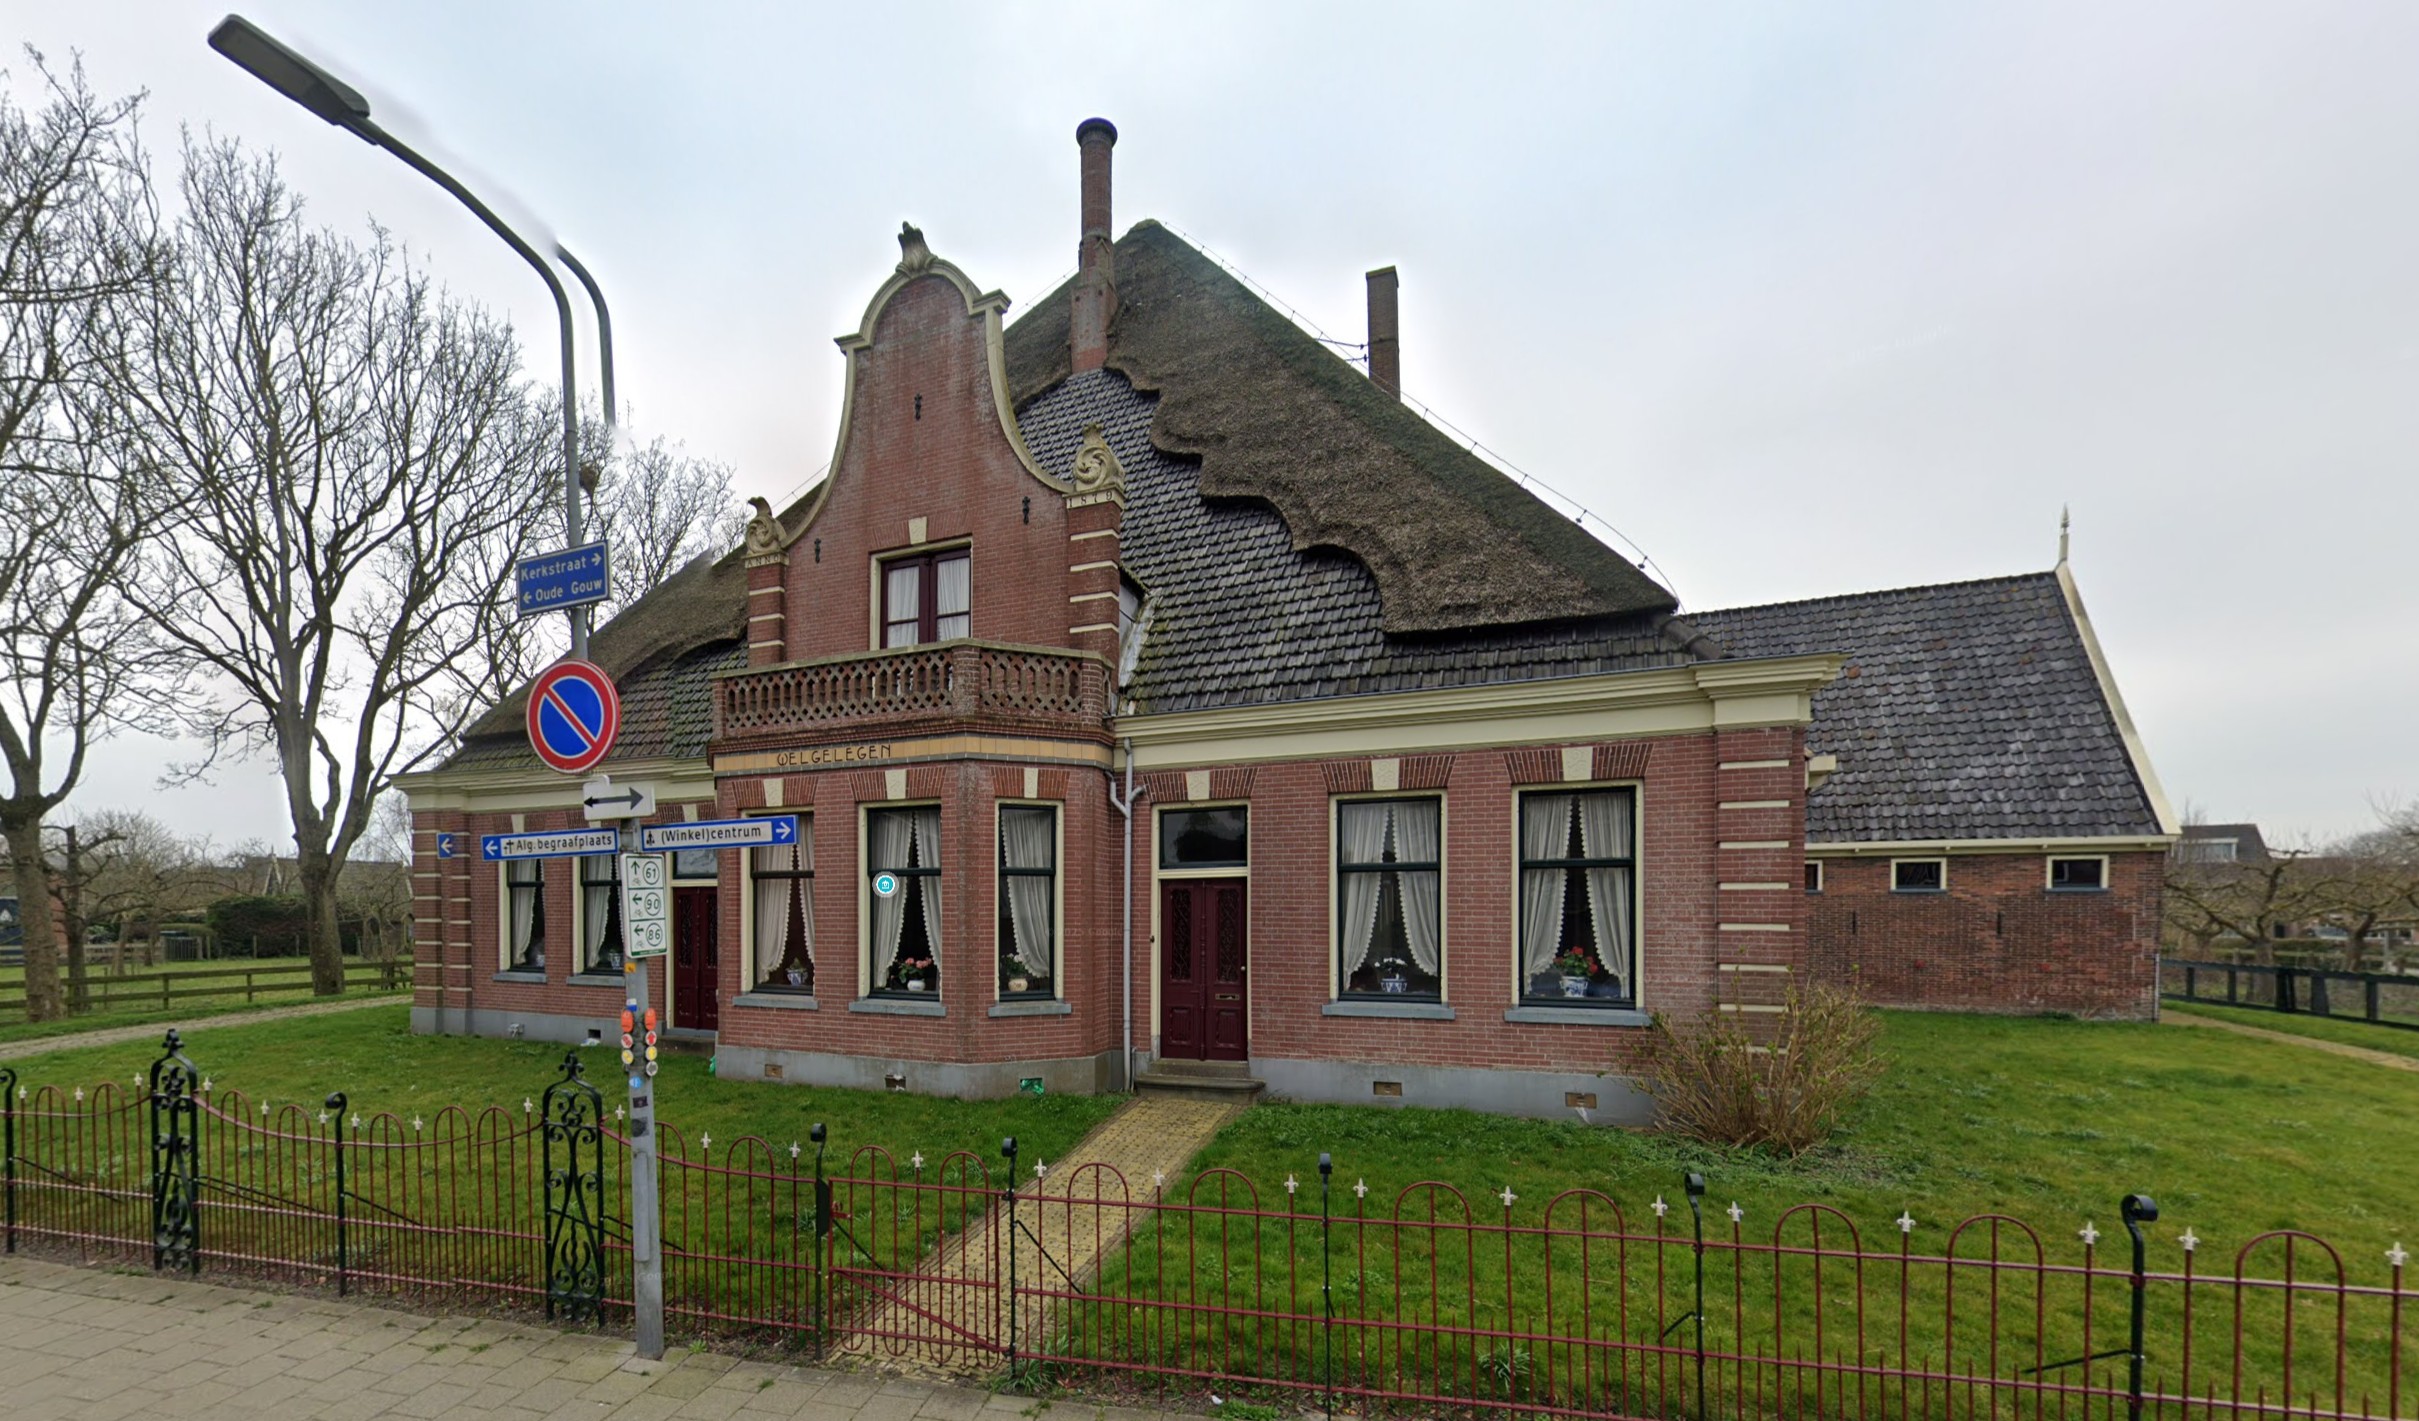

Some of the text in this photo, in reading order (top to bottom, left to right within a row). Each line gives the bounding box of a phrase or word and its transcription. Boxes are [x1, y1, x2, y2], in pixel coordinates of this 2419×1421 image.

[1068, 490, 1113, 508] 1879
[520, 555, 587, 582] Kerkstraat
[747, 553, 780, 567] ANNO
[535, 579, 603, 602] Oude Gouw
[776, 743, 892, 767] WELGELEGEN
[661, 826, 762, 846] (Winkel)centrum
[645, 867, 657, 879] 61
[646, 898, 661, 910] 90
[647, 929, 661, 941] 86
